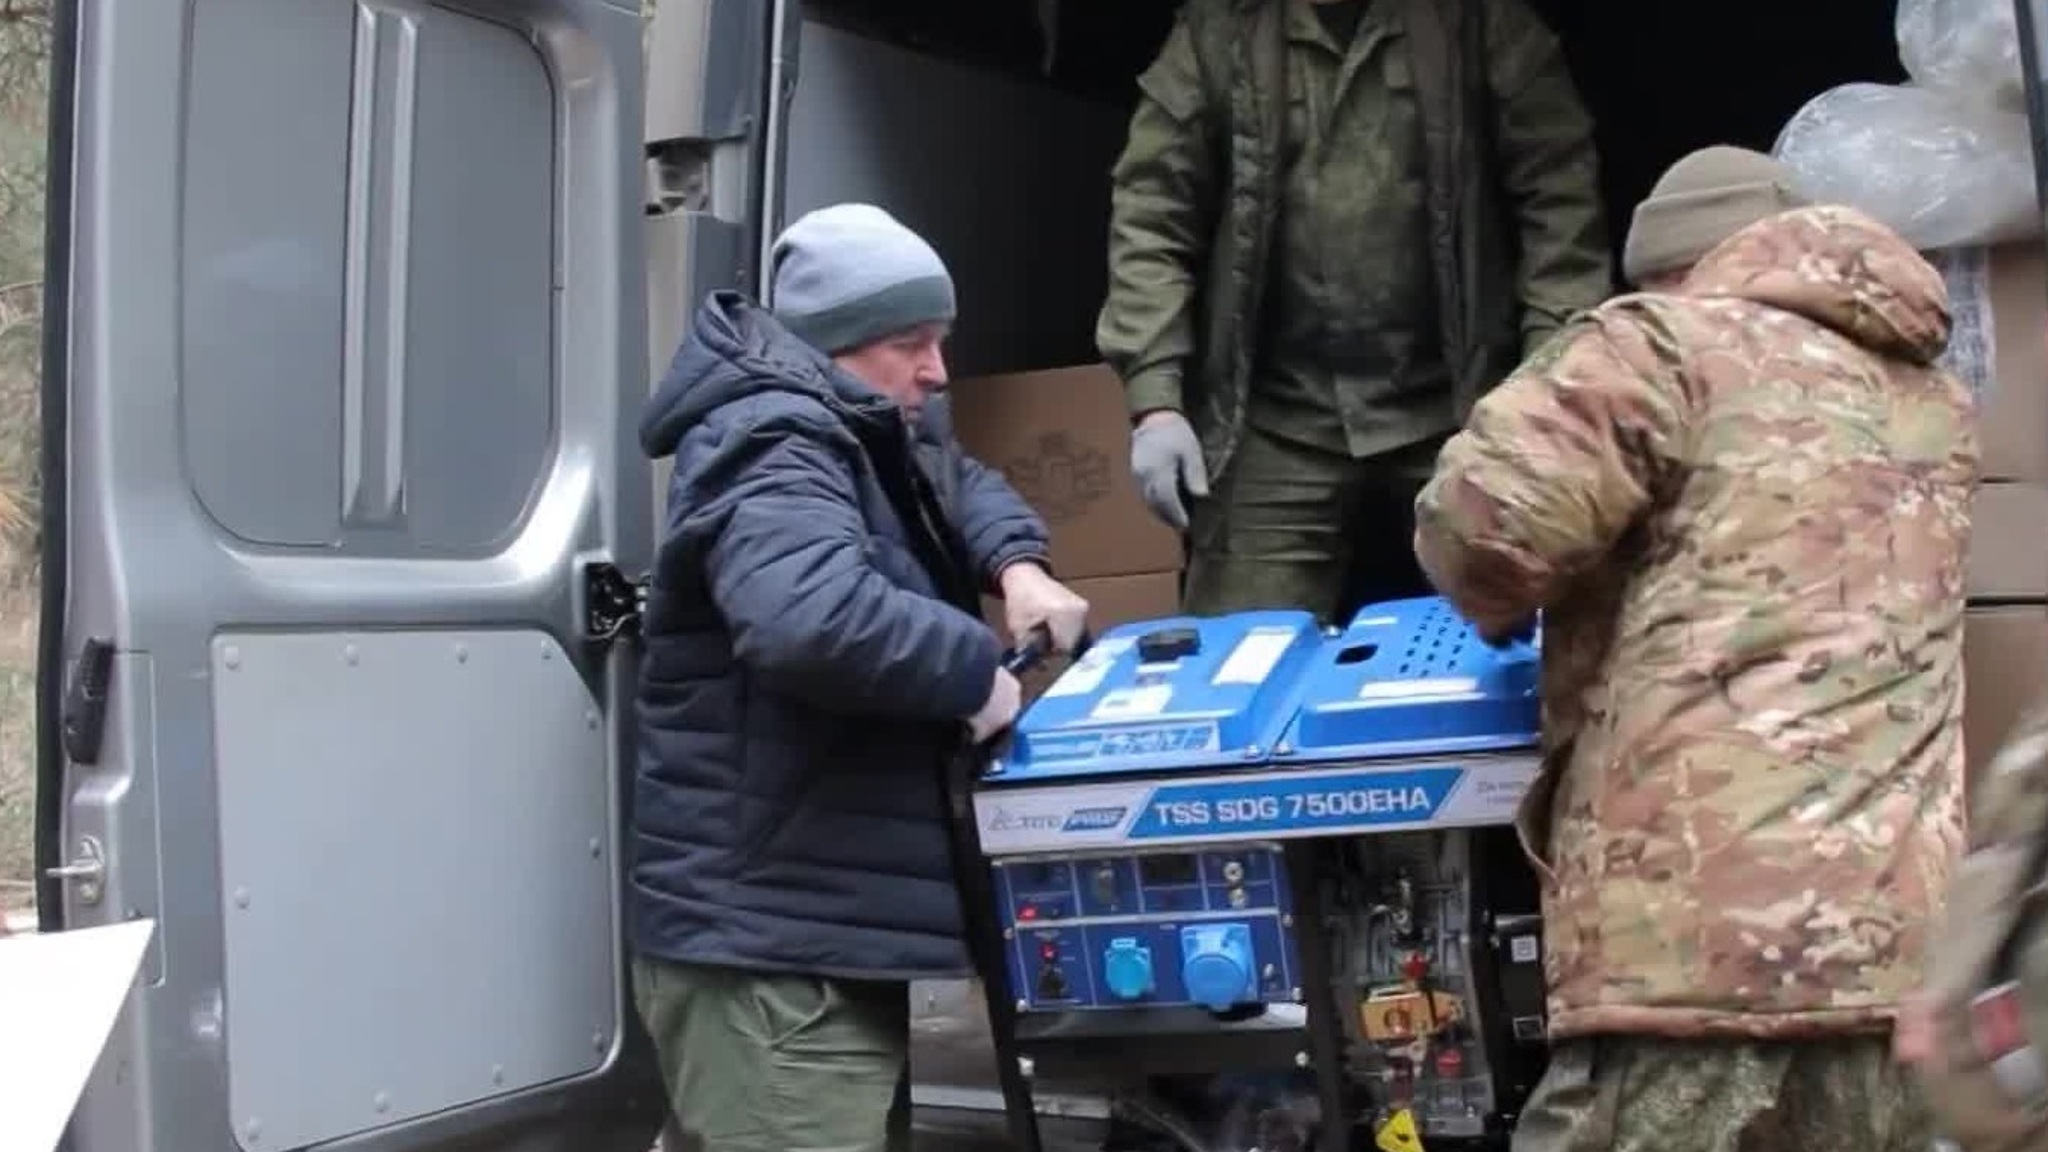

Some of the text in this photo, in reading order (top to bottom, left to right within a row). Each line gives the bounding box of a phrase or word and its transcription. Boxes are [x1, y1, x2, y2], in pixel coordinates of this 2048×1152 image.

[1155, 801, 1211, 826] TSS
[1217, 795, 1279, 821] SDG
[1285, 786, 1430, 819] 7500EHA
